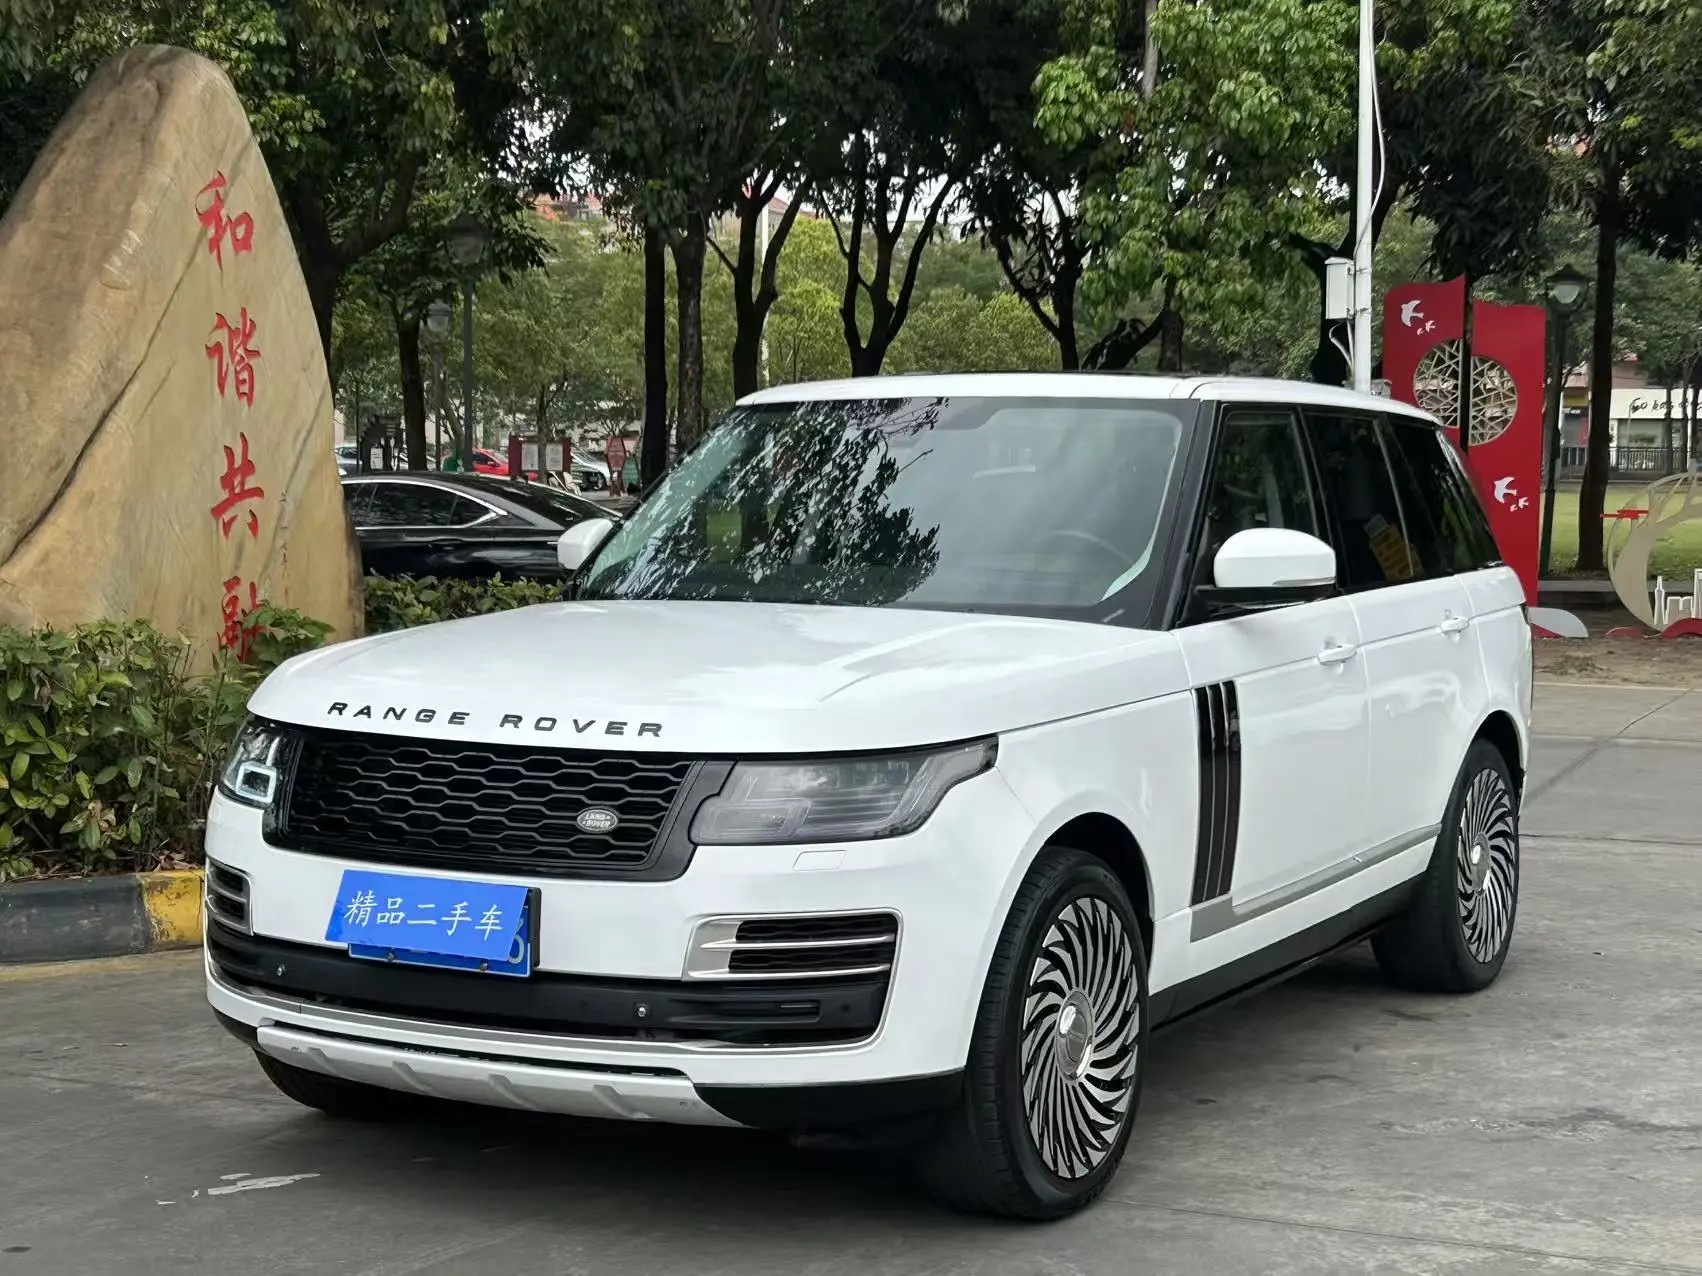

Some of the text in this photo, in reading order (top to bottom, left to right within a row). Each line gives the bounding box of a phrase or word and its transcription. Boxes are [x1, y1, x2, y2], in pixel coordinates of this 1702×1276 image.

[328, 702, 662, 738] RANGE ROVER
[584, 812, 606, 820] LAND
[586, 820, 611, 828] ROVER
[343, 890, 503, 942] 精品二手车
